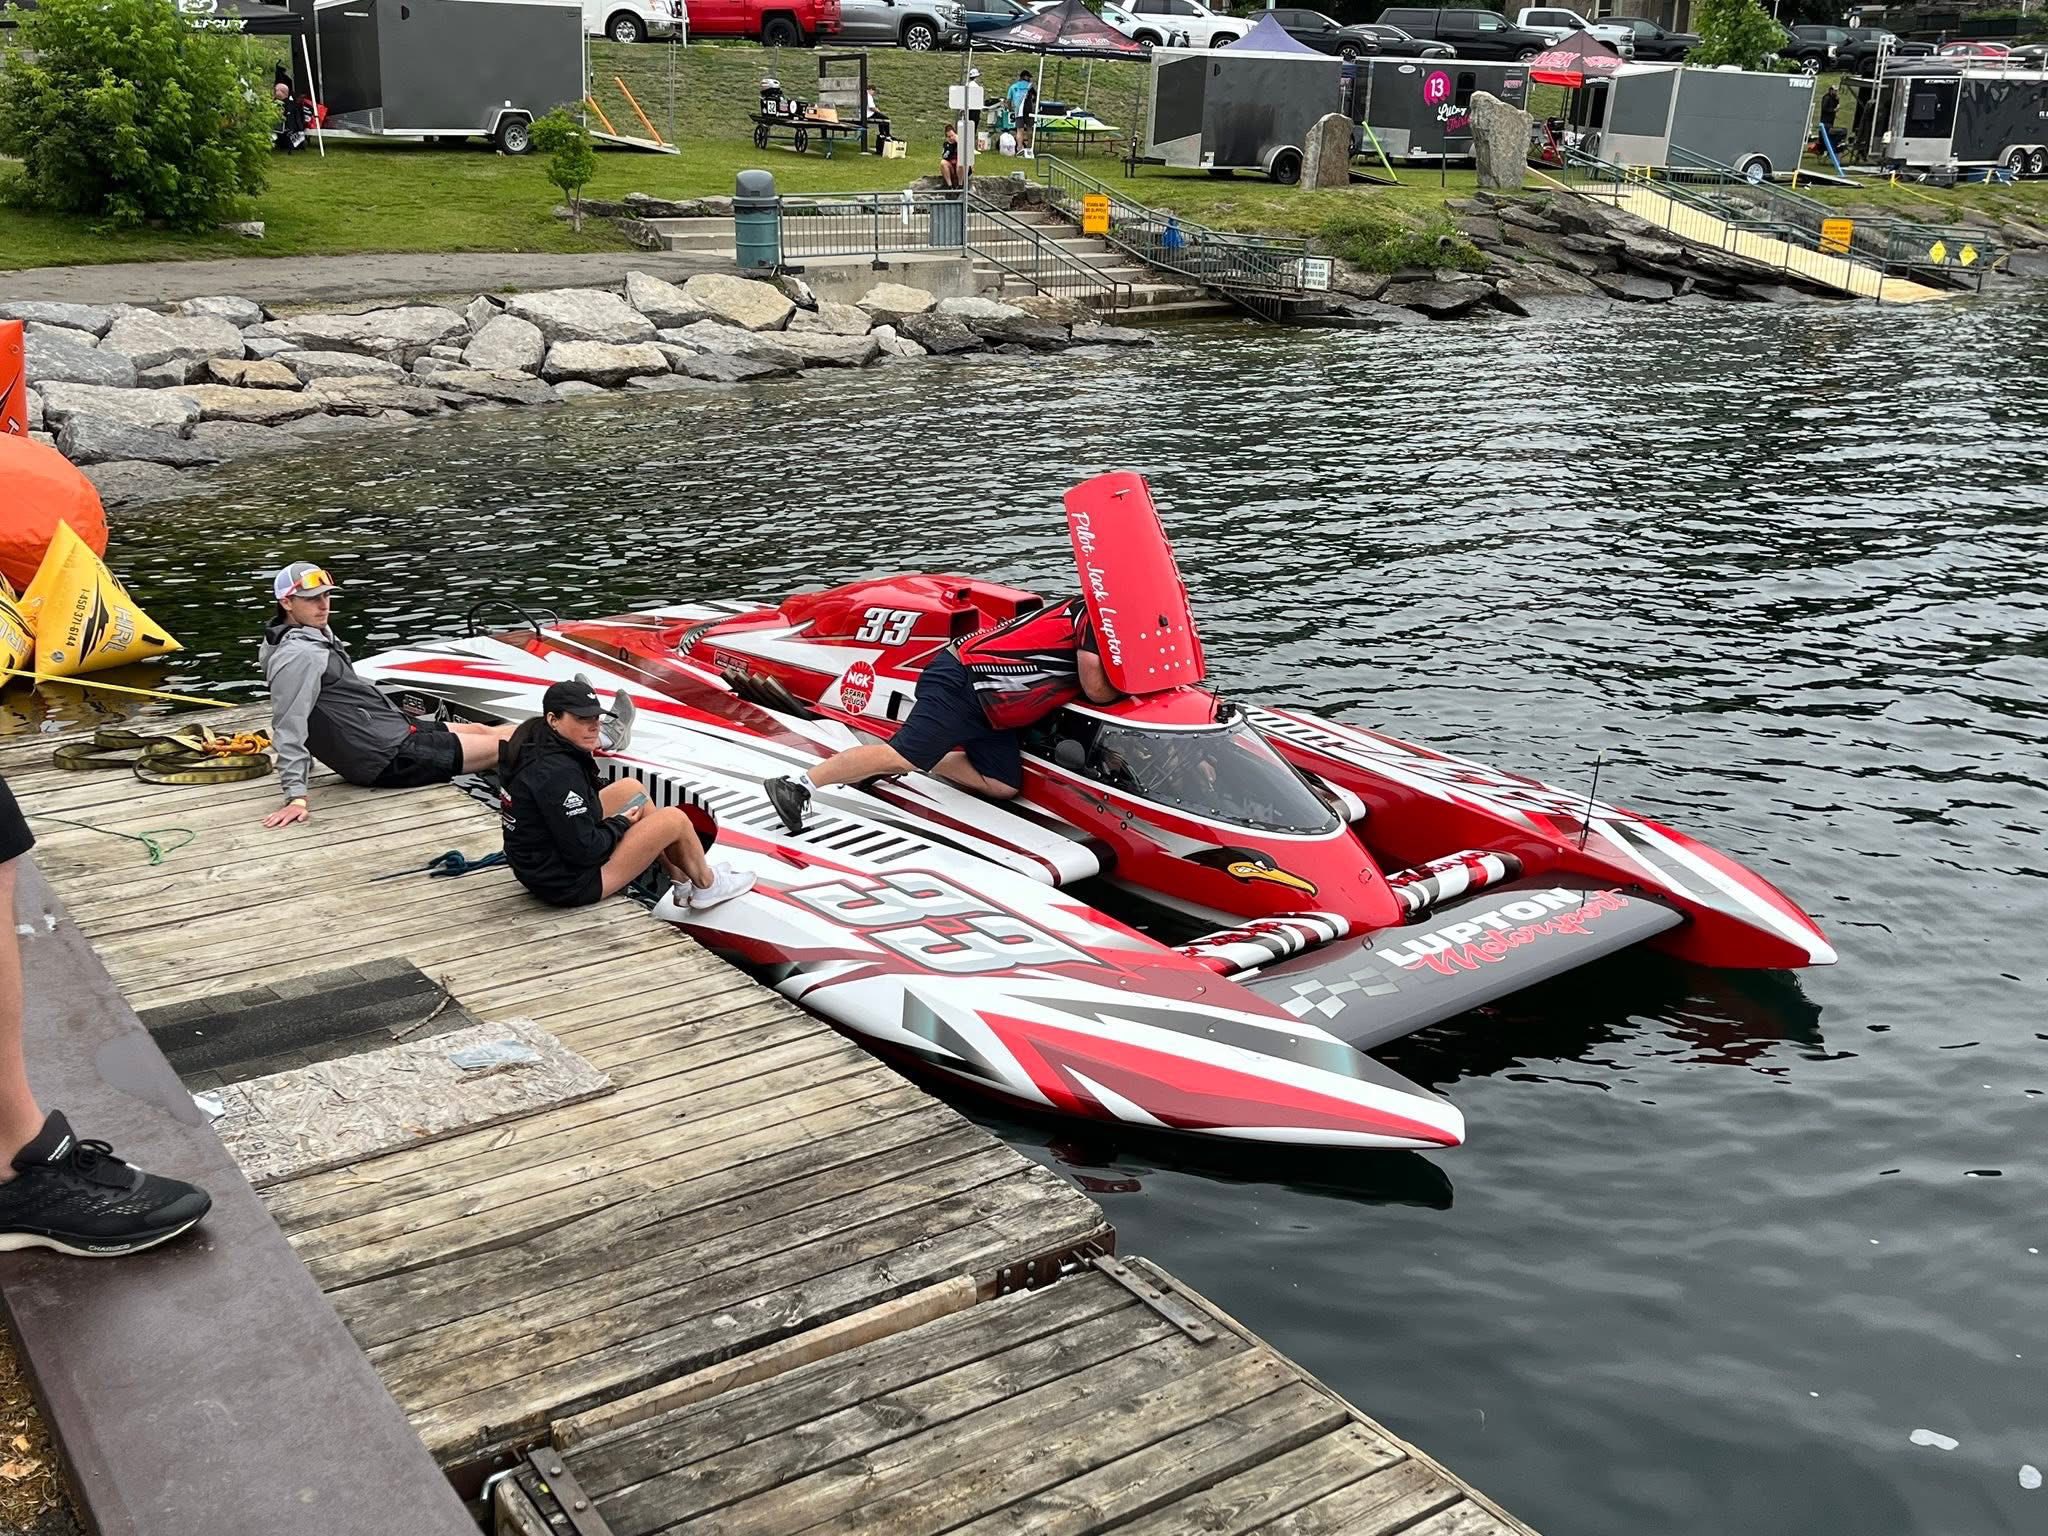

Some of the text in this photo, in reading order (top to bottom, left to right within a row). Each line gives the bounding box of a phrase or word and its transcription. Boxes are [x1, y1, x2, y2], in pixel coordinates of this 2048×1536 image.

[1431, 77, 1445, 97] 13
[100, 605, 135, 654] HRL
[855, 607, 924, 646] 33
[1087, 561, 1110, 603] Jack
[1099, 607, 1123, 666] Lupton
[842, 695, 866, 707] PLUGS
[845, 688, 866, 699] SPARK
[846, 671, 871, 689] NGK
[783, 868, 1103, 974] 33
[1376, 887, 1584, 967] LUPTON
[1403, 887, 1630, 976] Motorsport
